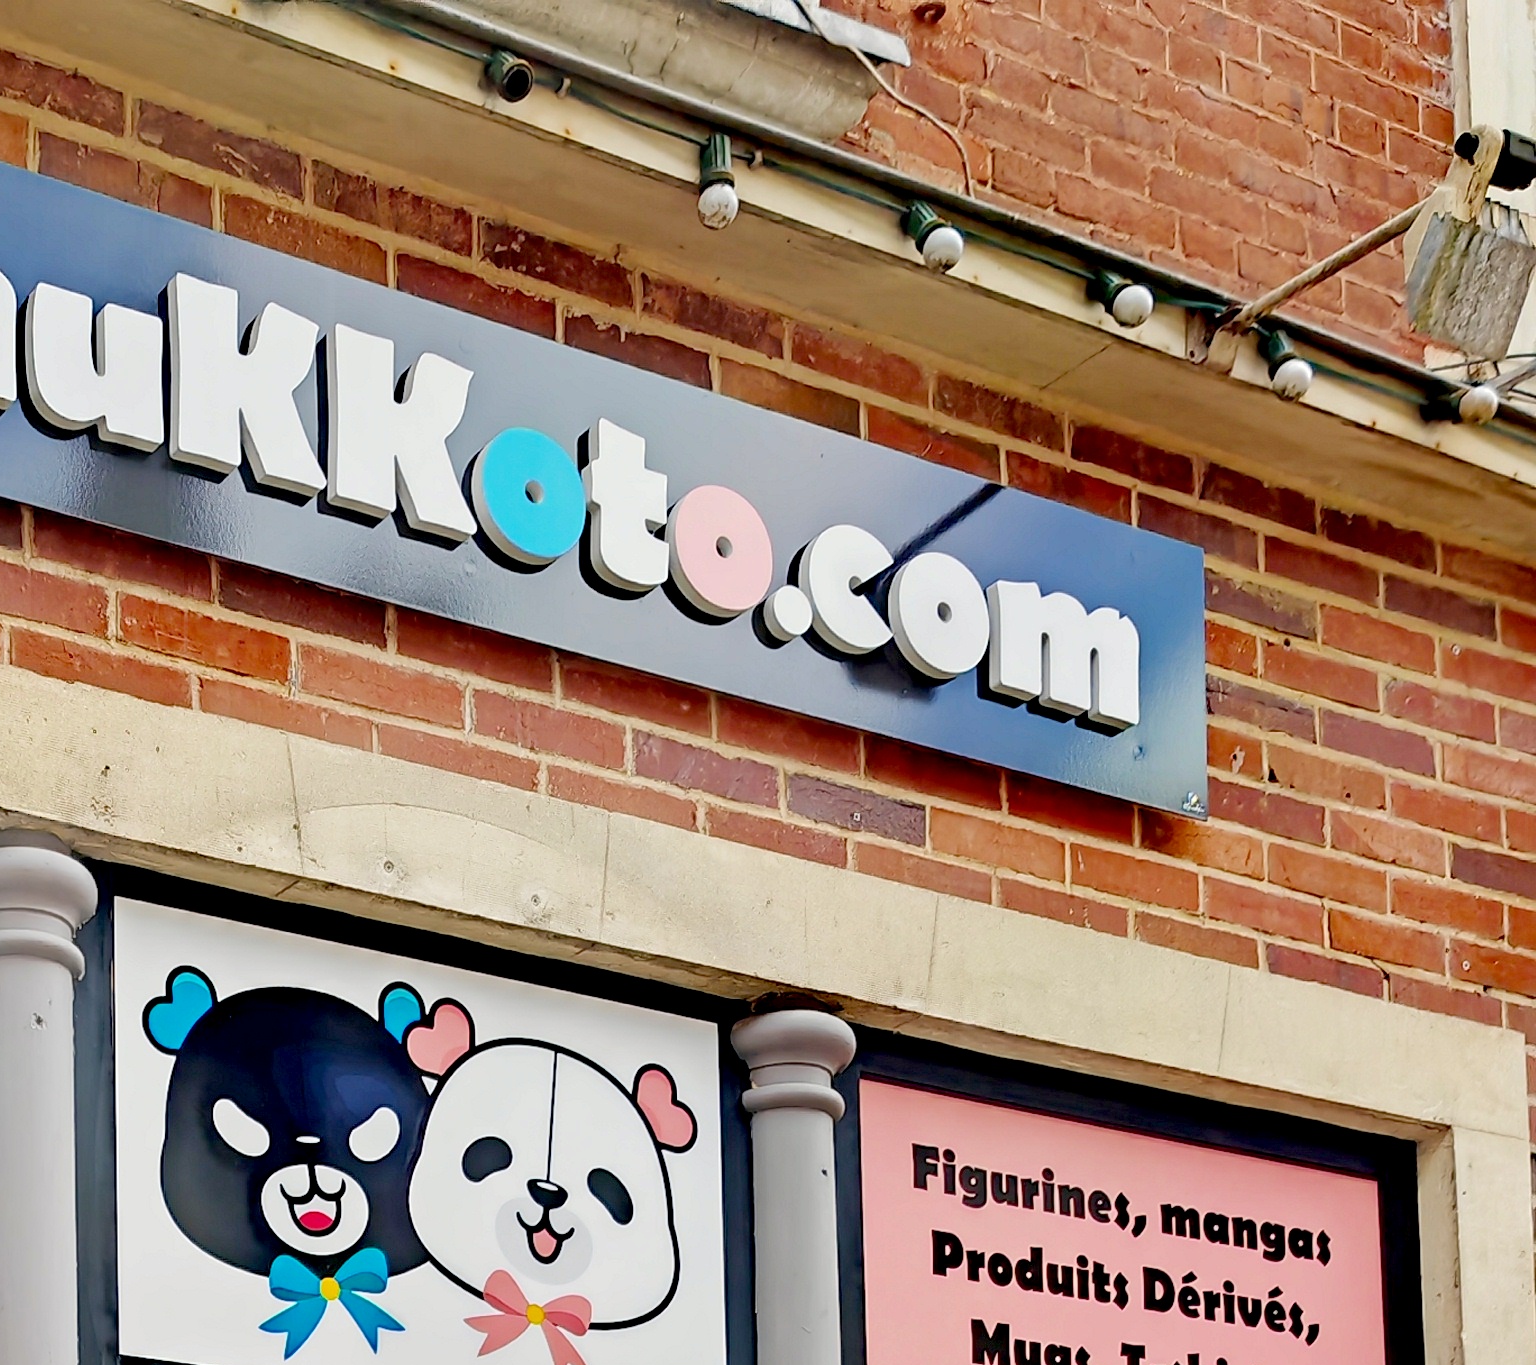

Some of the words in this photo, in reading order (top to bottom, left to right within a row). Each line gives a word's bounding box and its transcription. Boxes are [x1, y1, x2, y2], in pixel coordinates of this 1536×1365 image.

[912, 1142, 1147, 1237] Figurines,
[1160, 1203, 1332, 1266] mangas
[931, 1230, 1129, 1309] Produits
[1143, 1267, 1321, 1346] Dérivés,
